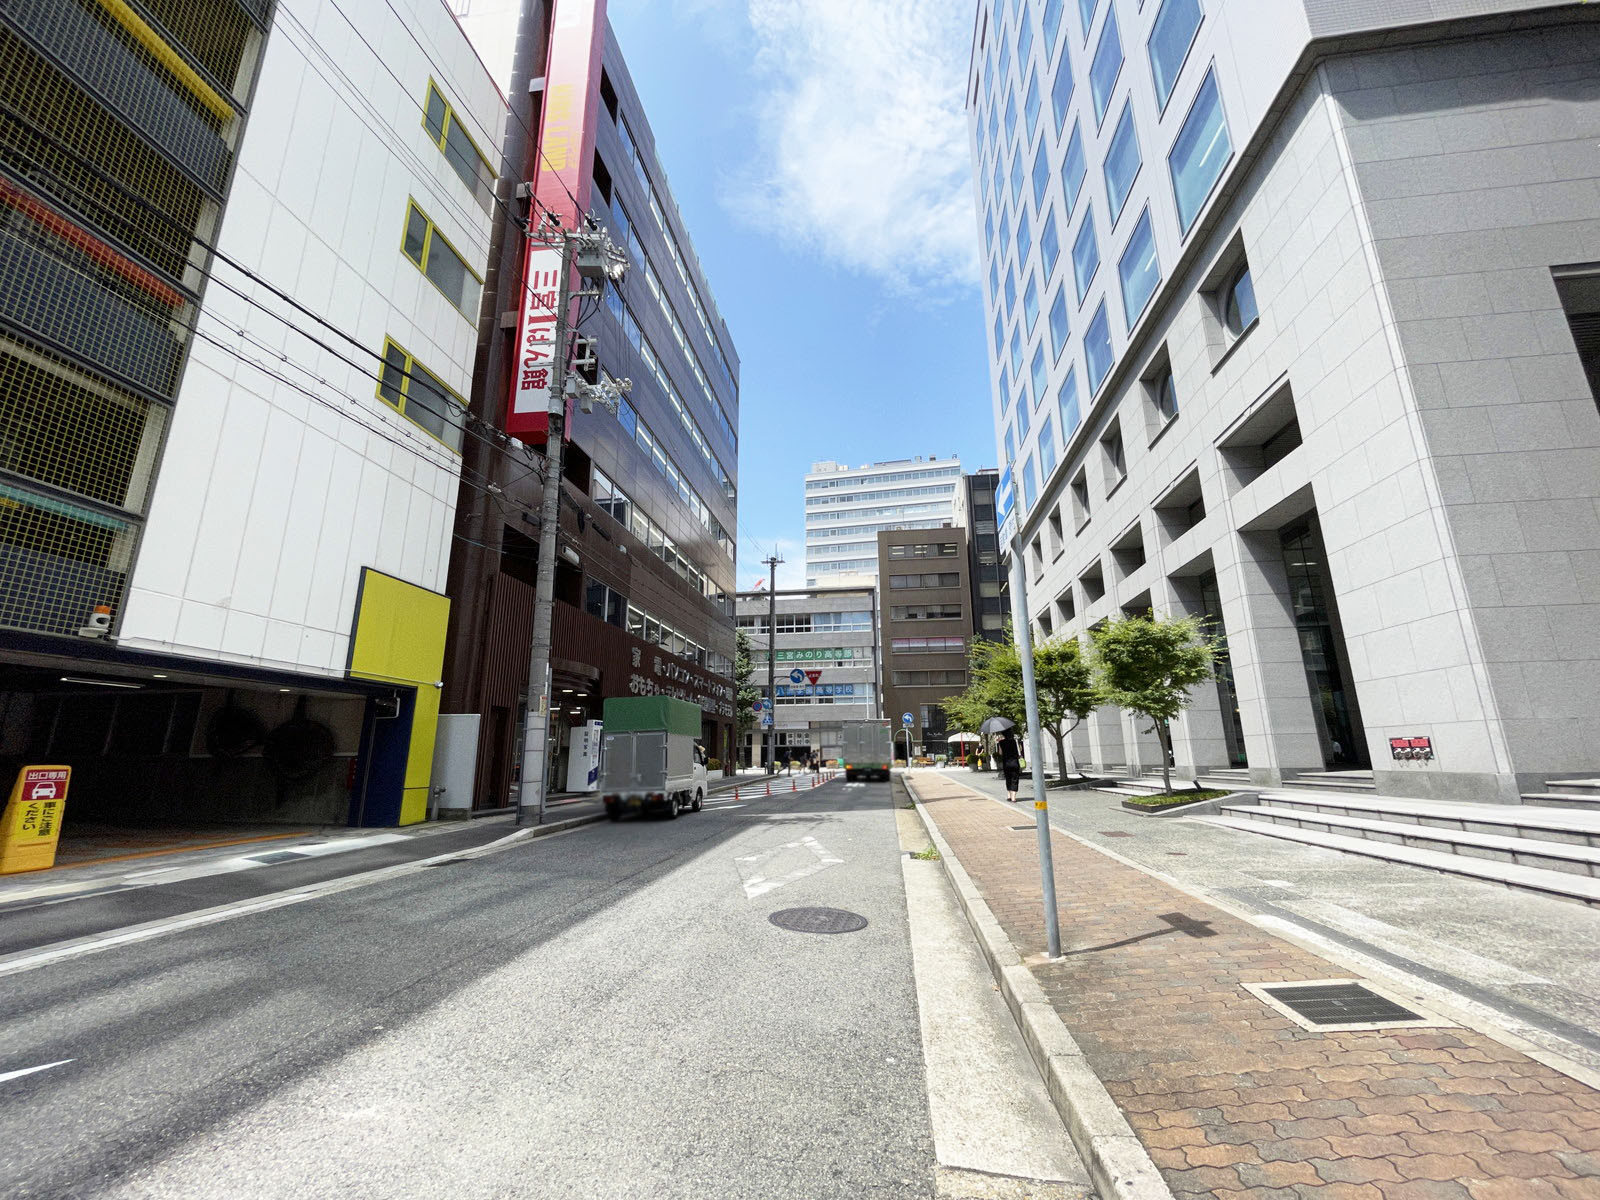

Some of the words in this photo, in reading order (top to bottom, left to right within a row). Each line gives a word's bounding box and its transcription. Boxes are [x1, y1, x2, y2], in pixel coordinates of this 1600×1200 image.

[27, 771, 67, 780] 出口専用
[22, 802, 39, 830] ください
[38, 801, 56, 837] 車にご注意
